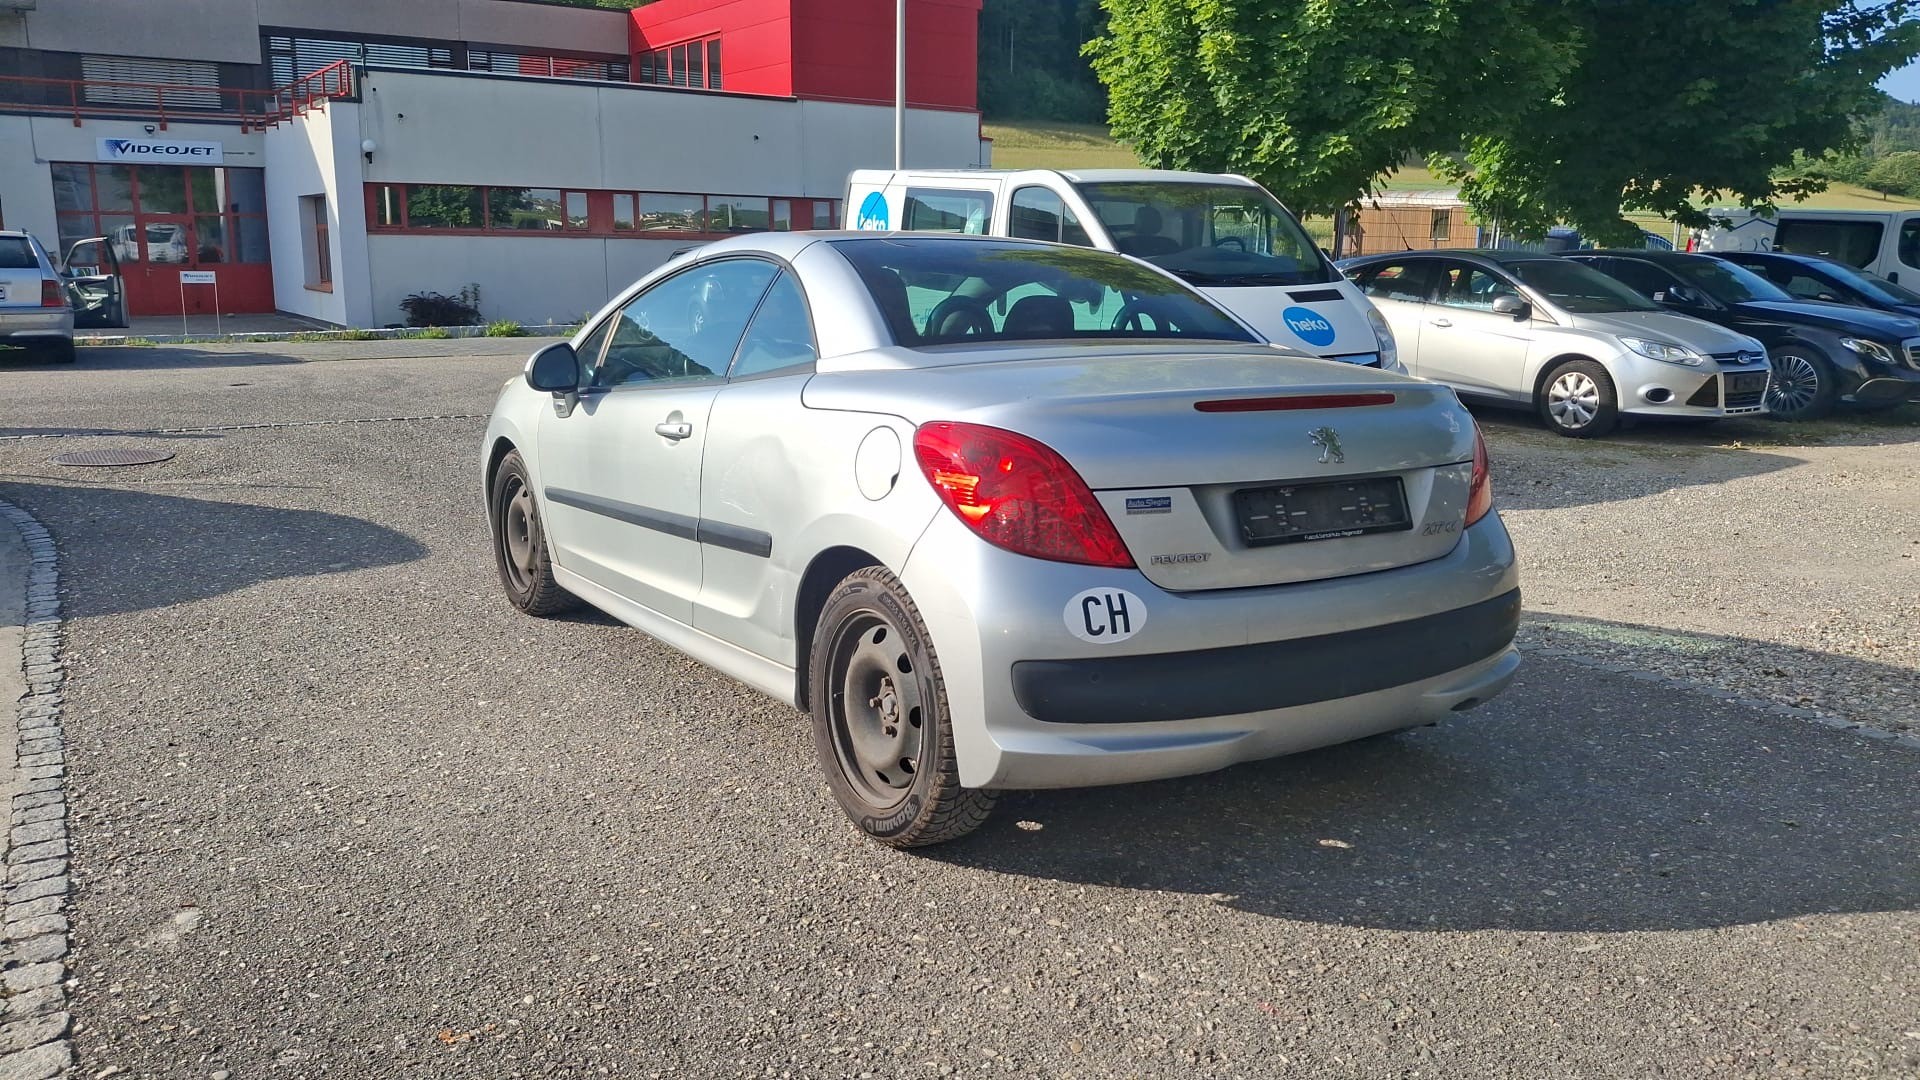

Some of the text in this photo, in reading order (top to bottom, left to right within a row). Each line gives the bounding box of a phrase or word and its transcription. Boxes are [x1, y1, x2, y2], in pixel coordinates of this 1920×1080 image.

[117, 142, 214, 156] VIDEOJET
[1287, 317, 1329, 332] heko
[1151, 552, 1212, 566] PEUGEOT
[1081, 592, 1131, 637] CH
[875, 801, 918, 832] Barum
